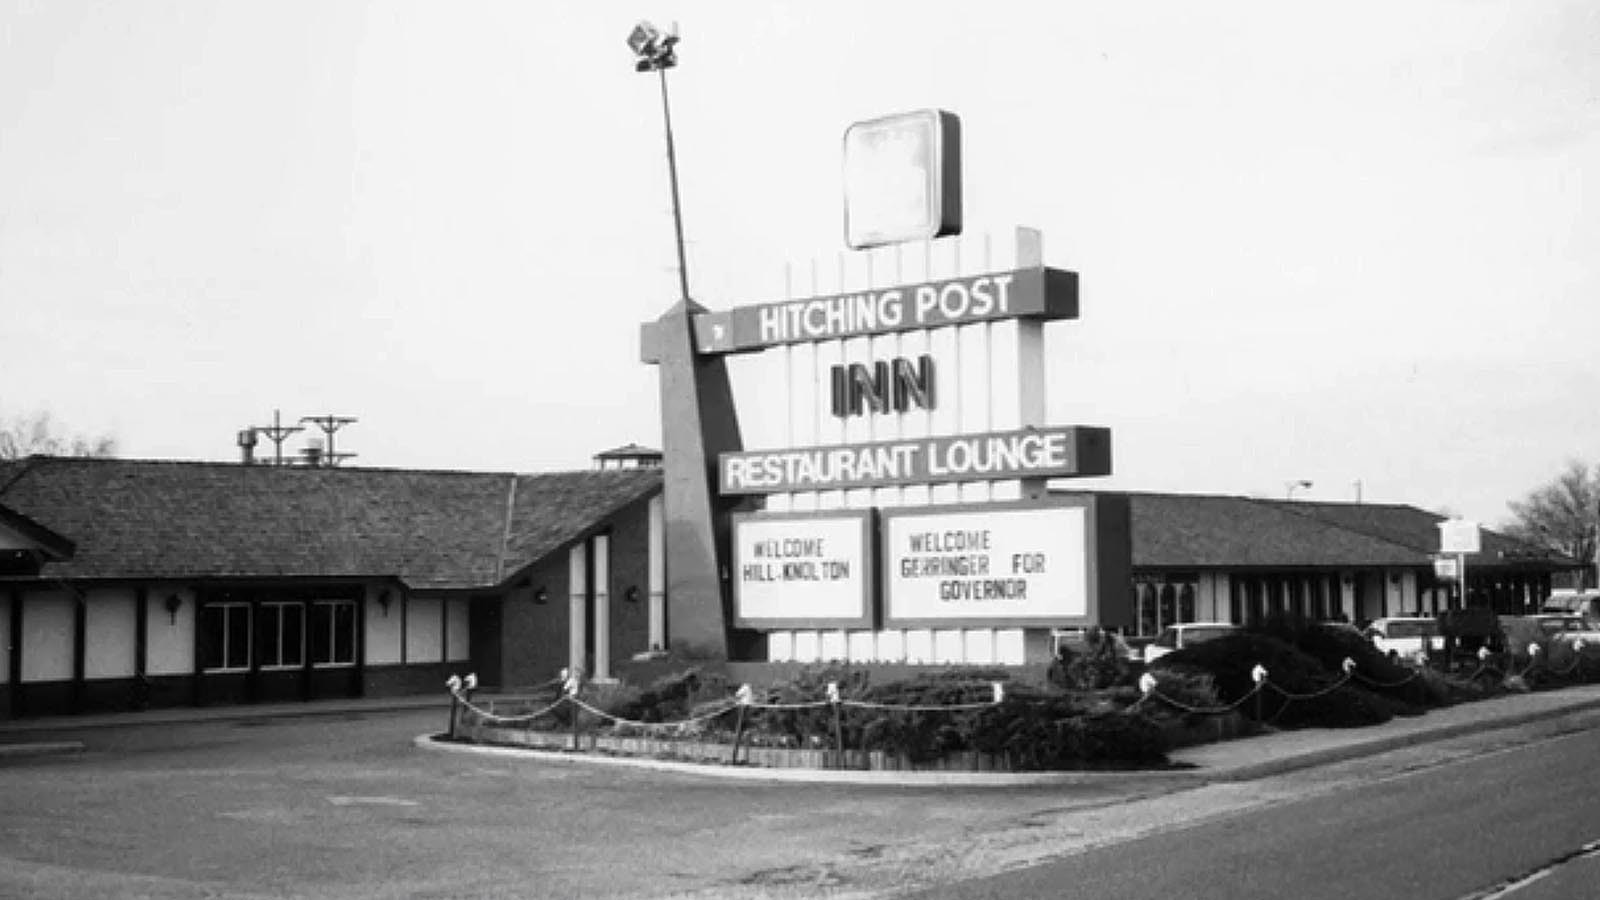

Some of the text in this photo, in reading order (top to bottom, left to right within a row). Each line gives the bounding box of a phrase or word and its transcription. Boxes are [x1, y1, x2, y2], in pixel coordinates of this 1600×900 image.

[760, 276, 1013, 341] HITCHING POST
[831, 354, 936, 417] INN
[726, 433, 1068, 488] RESTAURANT LOUNGE
[754, 538, 825, 557] WELCOME
[909, 531, 990, 552] WELCOME
[1012, 552, 1046, 574] FOR
[940, 579, 1027, 600] GOVERNOR
